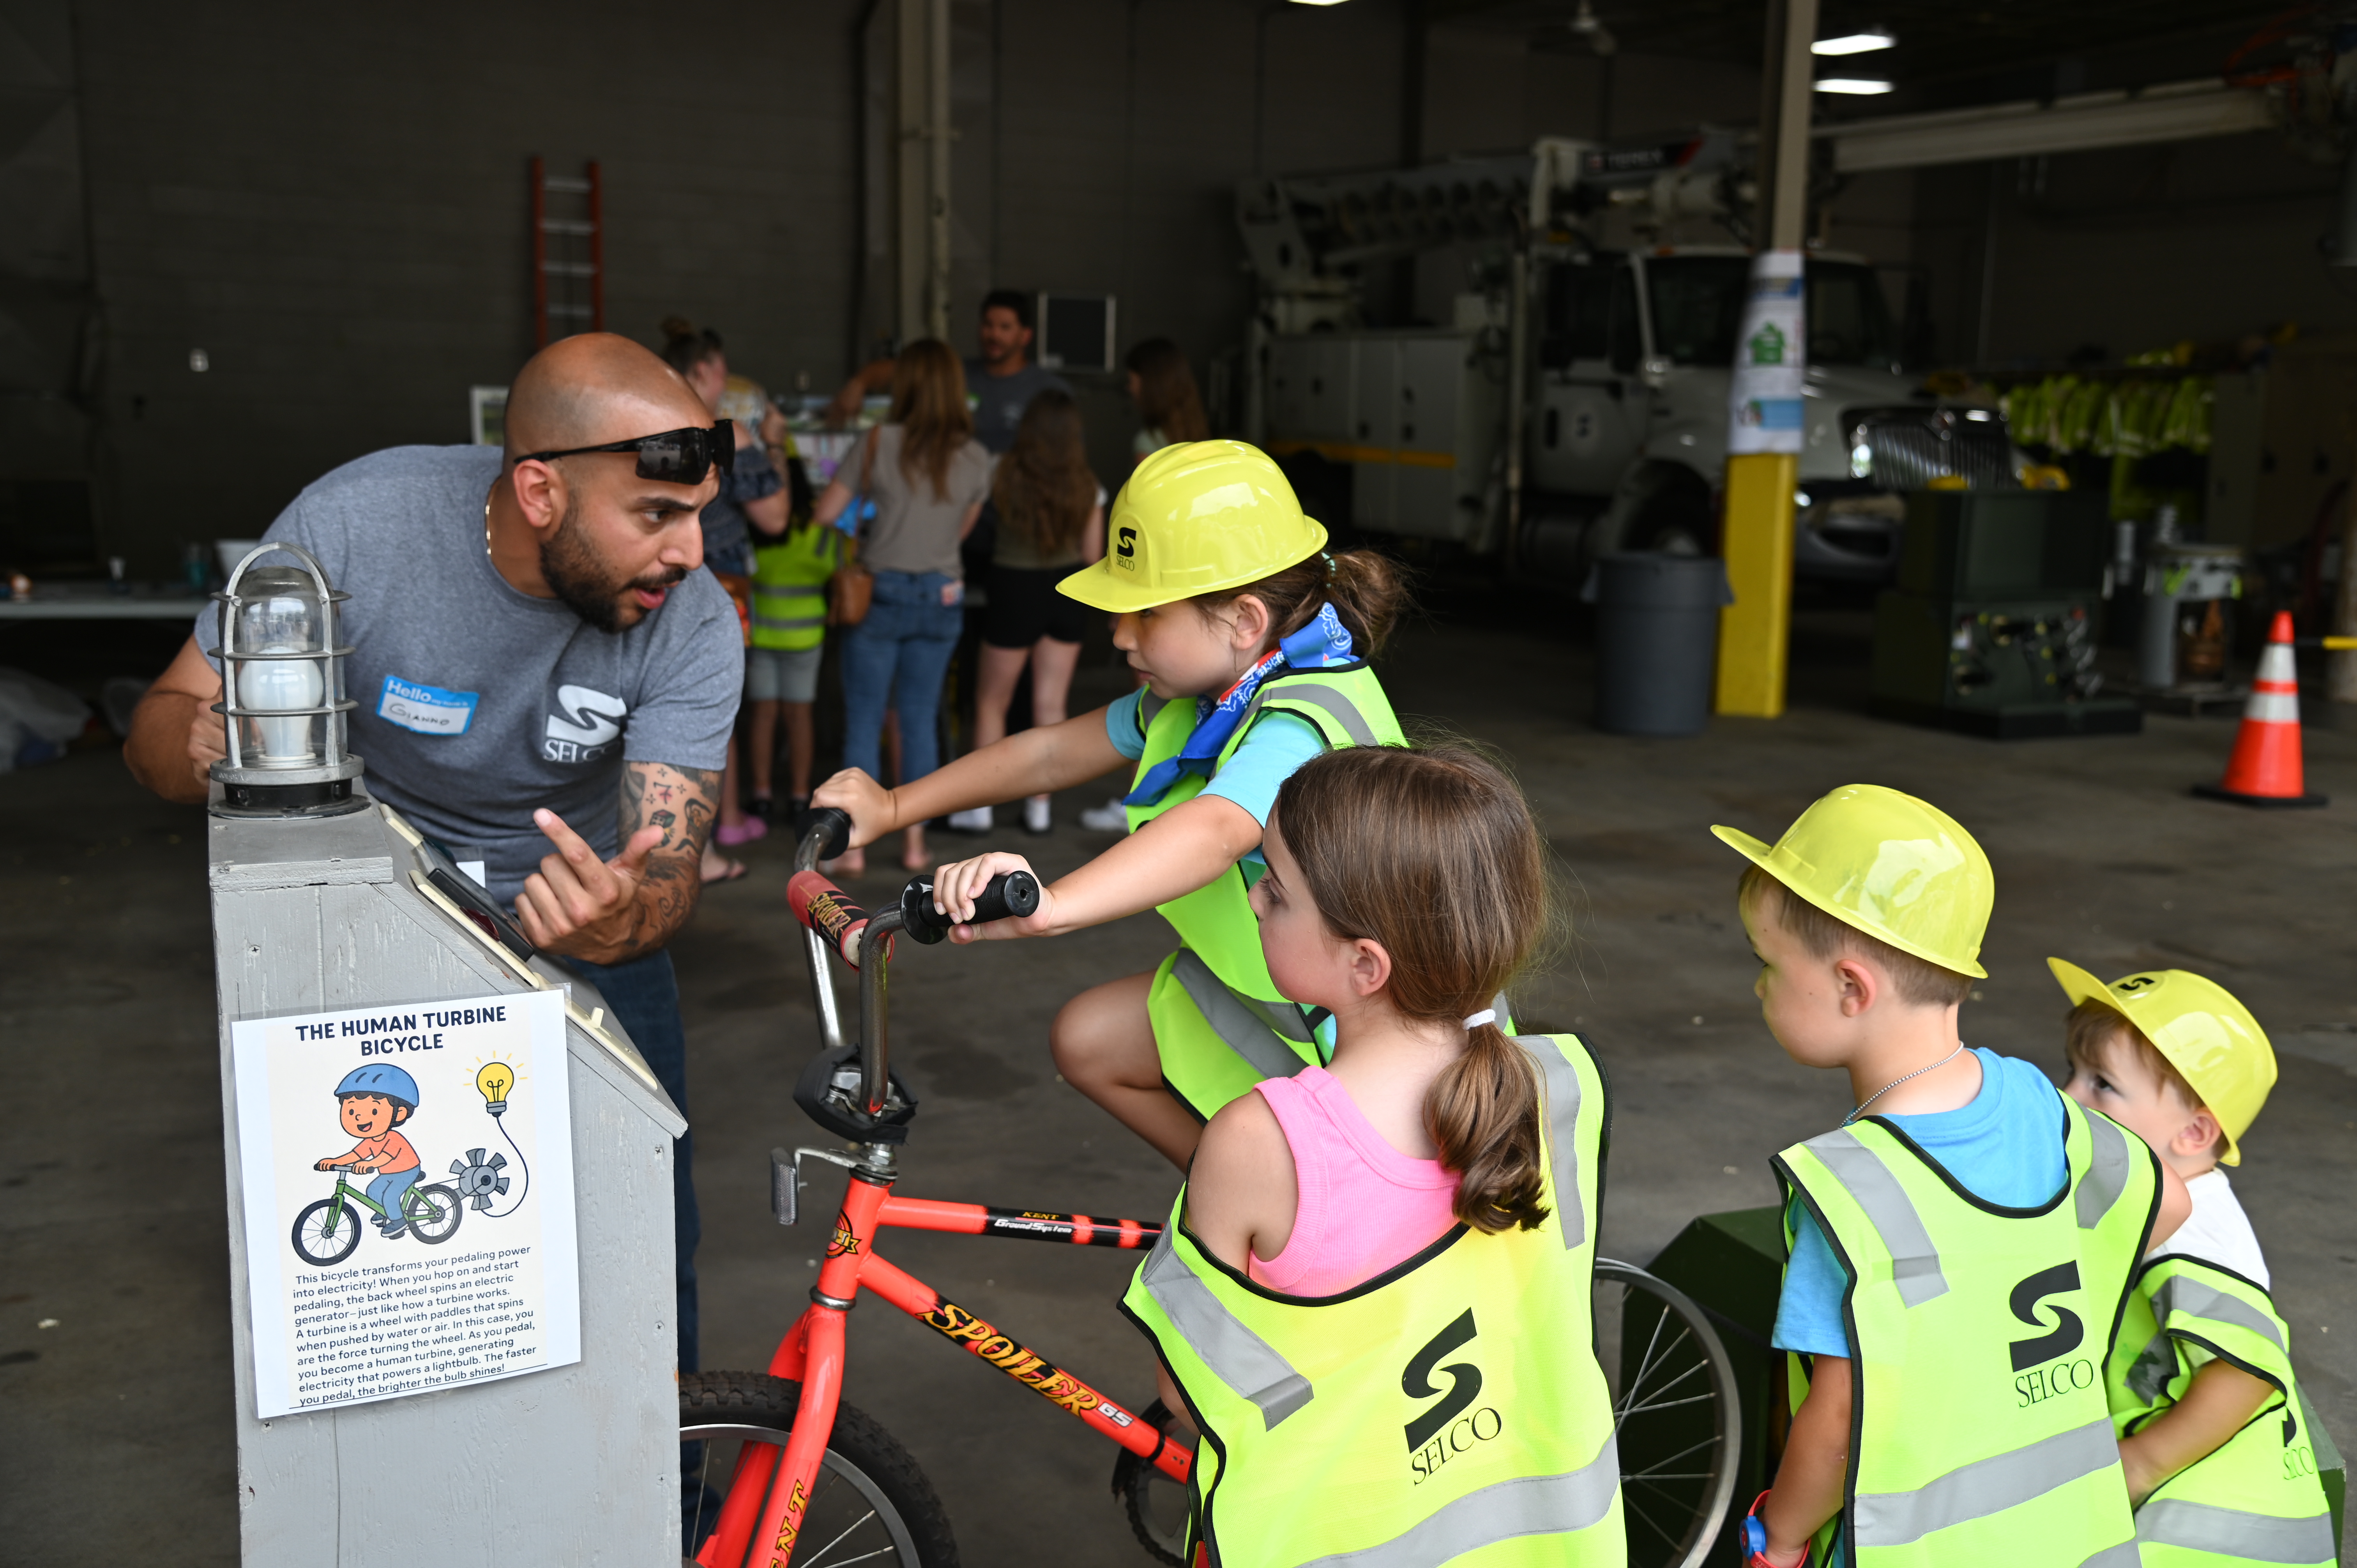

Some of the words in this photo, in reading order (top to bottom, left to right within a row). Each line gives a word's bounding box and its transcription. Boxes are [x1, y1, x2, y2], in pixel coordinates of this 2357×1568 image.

[1116, 555, 1134, 571] SELCO
[387, 679, 431, 702] Hello
[295, 1023, 335, 1041] THE
[342, 1014, 417, 1037] HUMAN
[423, 1006, 506, 1029] TURBINE
[361, 1033, 444, 1056] BICYCLE
[1022, 1211, 1060, 1220] KENT
[293, 1289, 315, 1298] into
[318, 1279, 376, 1295] electricity!
[379, 1277, 410, 1287] When
[412, 1274, 431, 1285] you
[434, 1270, 454, 1280] hop
[472, 1263, 491, 1274] and
[494, 1260, 519, 1271] start
[295, 1274, 318, 1285] This
[321, 1268, 359, 1282] bicycle
[362, 1262, 422, 1276] transforms
[425, 1258, 449, 1270] your
[451, 1251, 495, 1266] pedaling
[498, 1247, 531, 1259] power
[294, 1299, 344, 1314] pedaling,
[346, 1295, 364, 1305] the
[367, 1290, 393, 1302] back
[395, 1285, 427, 1298] wheel
[430, 1282, 457, 1295] spins
[475, 1273, 514, 1287] electric
[381, 1303, 399, 1313] like
[402, 1301, 424, 1310] how
[436, 1293, 474, 1305] turbine
[476, 1287, 510, 1299] works.
[296, 1330, 304, 1339] A
[306, 1324, 346, 1337] turbine
[349, 1322, 358, 1331] is
[369, 1315, 401, 1328] wheel
[404, 1312, 428, 1323] with
[430, 1307, 471, 1322] paddles
[473, 1302, 495, 1313] that
[498, 1298, 524, 1310] spins
[297, 1342, 327, 1352] when
[329, 1333, 369, 1350] pushed
[371, 1332, 384, 1343] by
[387, 1328, 418, 1339] water
[435, 1322, 450, 1332] air.
[453, 1321, 462, 1329] In
[465, 1317, 484, 1327] this
[487, 1314, 513, 1324] case,
[515, 1310, 534, 1321] you
[297, 1357, 315, 1366] are
[317, 1353, 336, 1363] the
[338, 1349, 367, 1360] force
[369, 1342, 409, 1354] turning
[411, 1339, 429, 1348] the
[432, 1332, 466, 1345] wheel.
[468, 1331, 481, 1340] As
[484, 1328, 502, 1339] you
[505, 1321, 535, 1336] pedal,
[298, 1370, 318, 1381] you
[321, 1363, 364, 1376] become
[376, 1356, 412, 1367] human
[414, 1348, 456, 1361] turbine,
[458, 1338, 514, 1356] generating
[917, 1303, 1099, 1419] SPOILER
[299, 1377, 354, 1392] electricity
[357, 1372, 380, 1383] that
[382, 1367, 421, 1382] powers
[433, 1356, 481, 1372] lightbulb.
[484, 1353, 503, 1362] The
[505, 1347, 537, 1358] faster
[300, 1396, 319, 1407] you
[322, 1389, 355, 1403] pedal,
[357, 1386, 375, 1396] the
[378, 1380, 422, 1393] brighter
[424, 1376, 442, 1385] the
[444, 1370, 467, 1382] bulb
[470, 1363, 504, 1377] shines!
[2015, 1359, 2094, 1409] SELCO
[1412, 1407, 1502, 1487] SELCO
[2283, 1446, 2315, 1480] SCO
